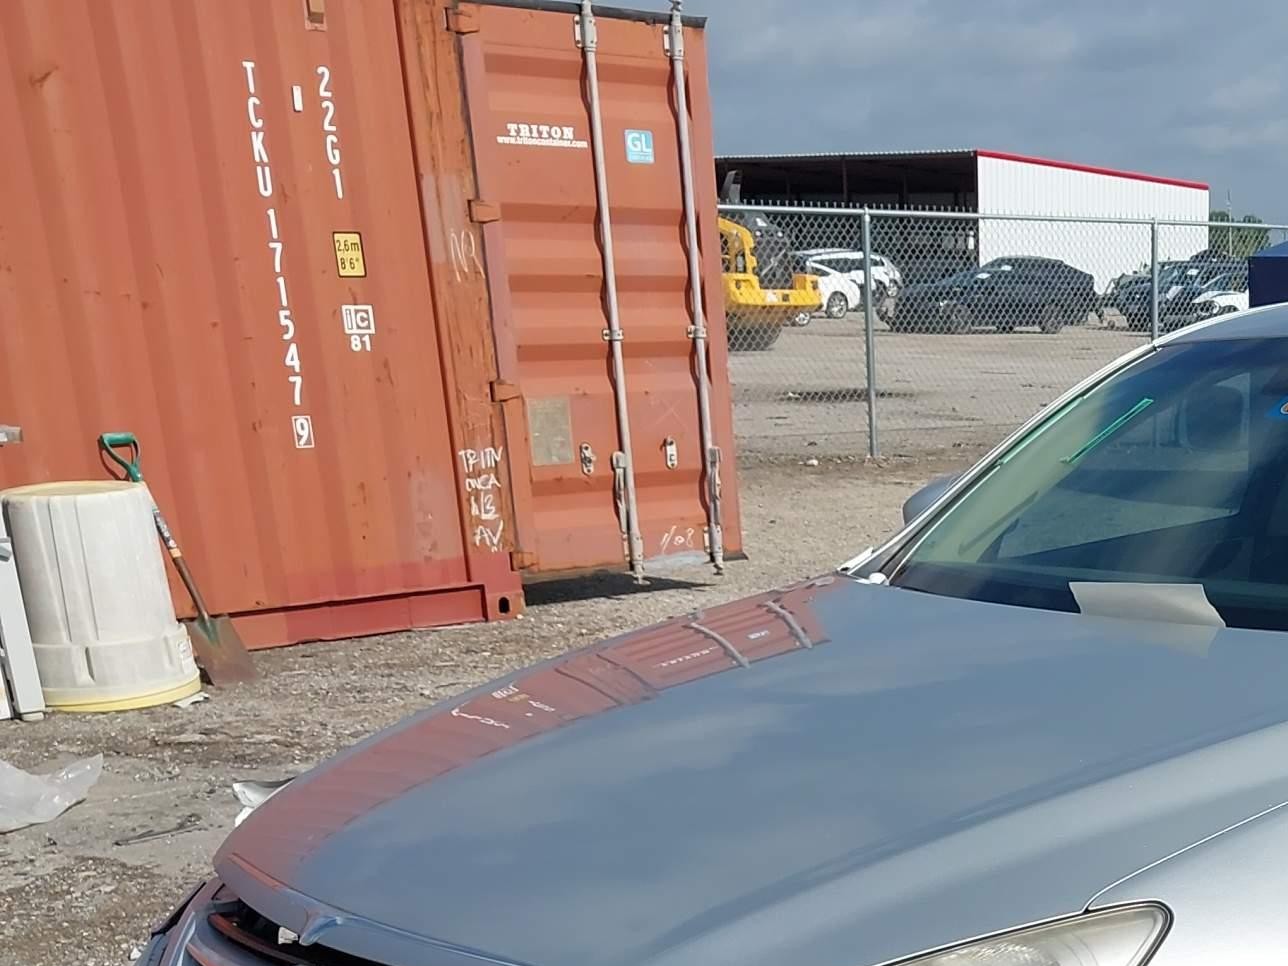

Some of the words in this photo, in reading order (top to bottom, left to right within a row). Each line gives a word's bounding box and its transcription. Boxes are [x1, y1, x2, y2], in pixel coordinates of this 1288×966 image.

[316, 66, 343, 199] 22G1
[506, 123, 574, 140] TRITON
[627, 132, 653, 153] GL
[242, 61, 272, 197] TCKU
[266, 208, 302, 405] 171547
[350, 334, 372, 351] 81
